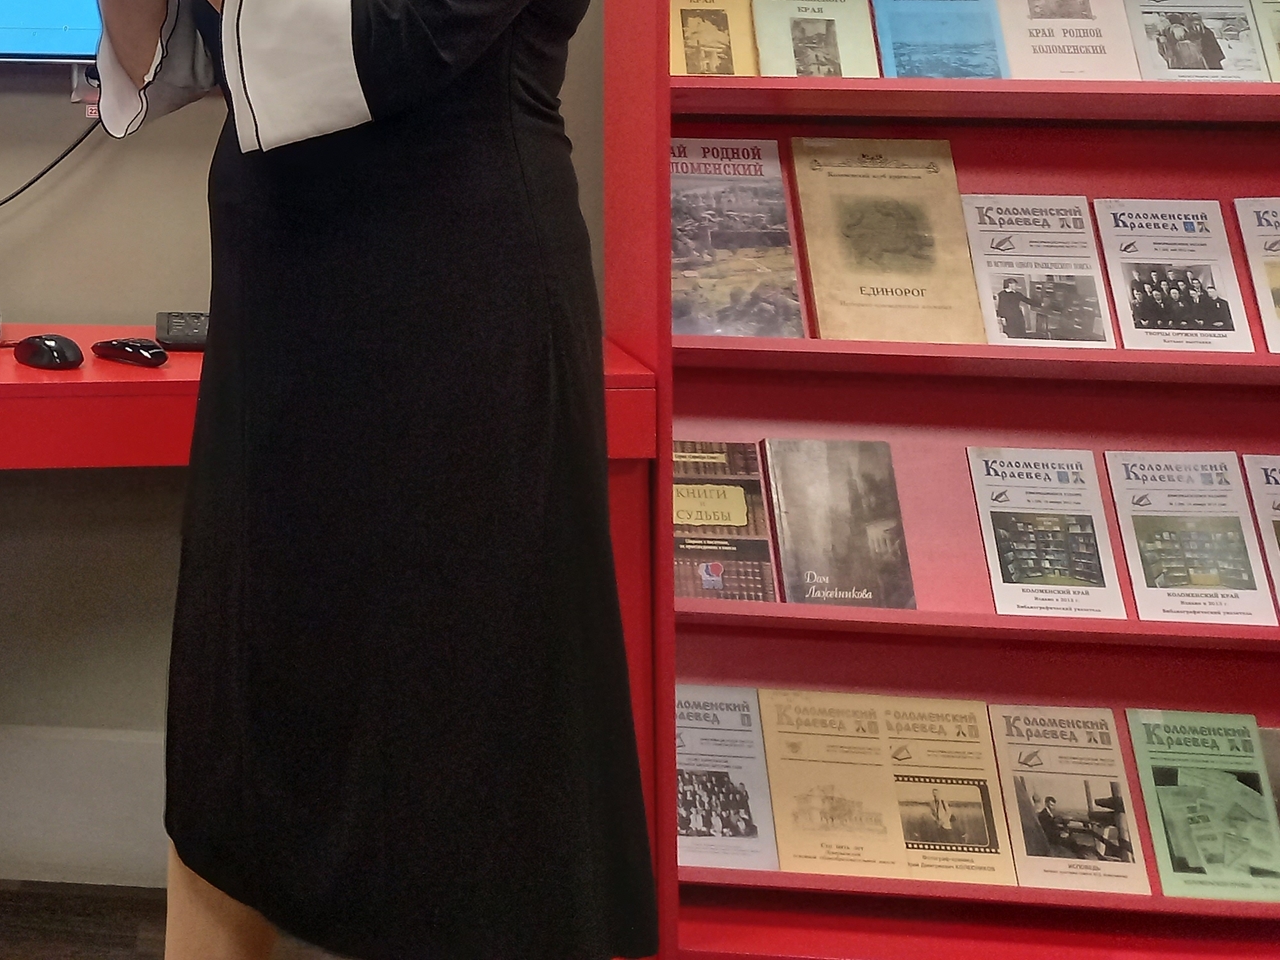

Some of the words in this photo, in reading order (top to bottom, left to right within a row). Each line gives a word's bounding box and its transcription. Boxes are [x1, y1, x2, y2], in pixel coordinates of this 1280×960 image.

[797, 6, 824, 14] КРАЯ
[1028, 27, 1055, 38] КРАЙ
[1061, 27, 1103, 38] РОДНОЙ
[1031, 44, 1107, 55] КОЛОМЕНСКИЙ
[701, 145, 762, 161] РОДНОЙ
[859, 286, 927, 297] ЕДИНОРОГ
[675, 487, 727, 500] КНИГИ
[676, 510, 732, 522] СУДЬБЫ
[804, 570, 829, 584] Дом
[805, 585, 873, 601] Лажечникова
